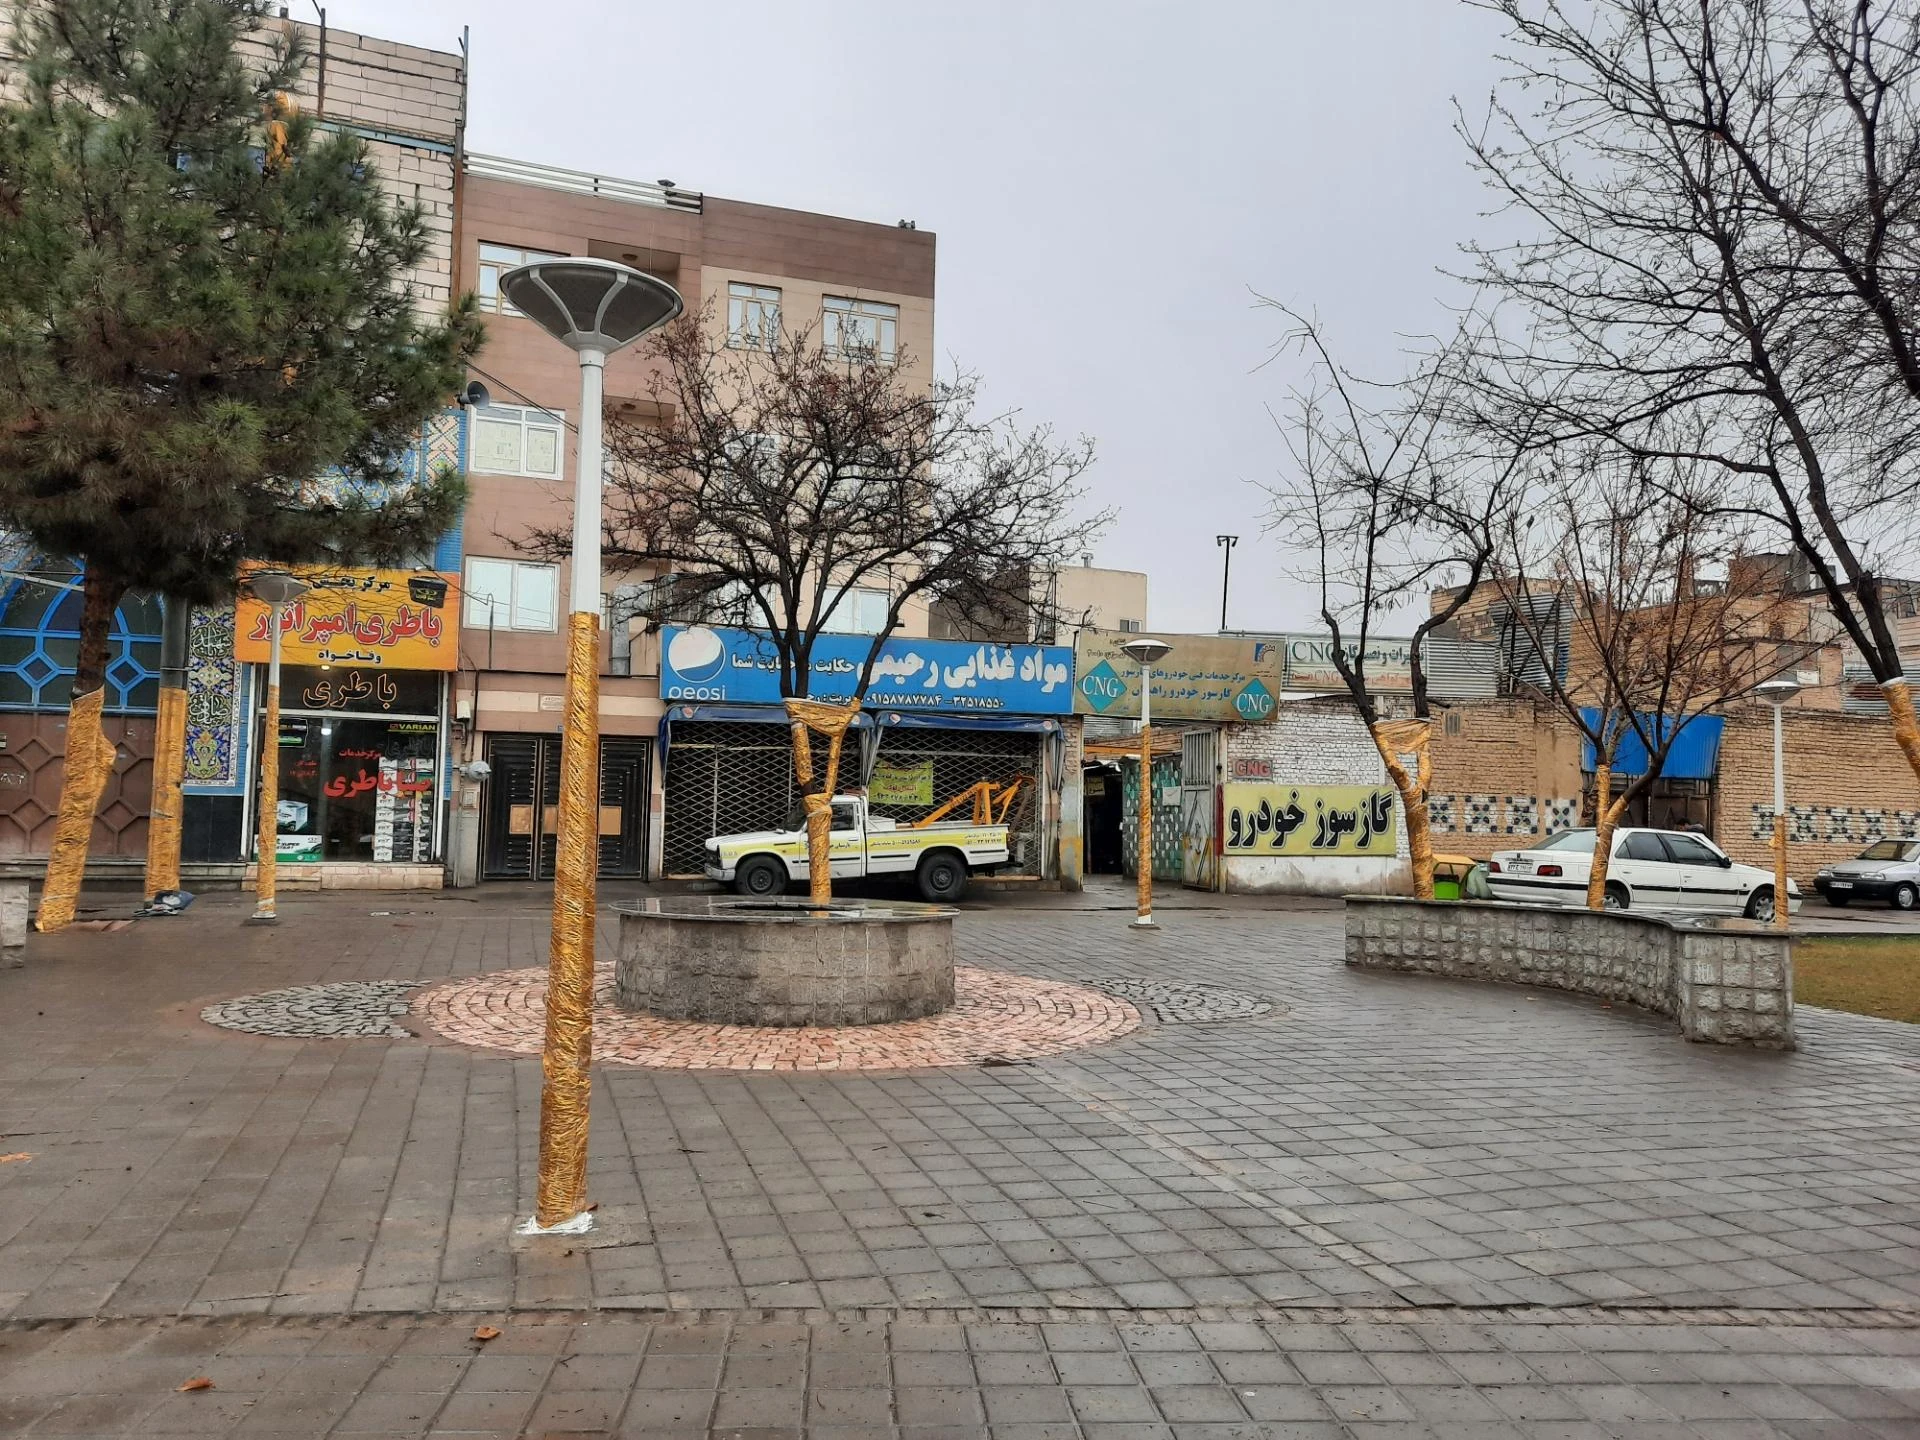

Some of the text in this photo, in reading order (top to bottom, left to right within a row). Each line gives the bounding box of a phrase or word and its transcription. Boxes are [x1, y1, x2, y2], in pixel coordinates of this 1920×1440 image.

[354, 603, 442, 647] باطری
[318, 649, 382, 664] وفاخواه
[731, 653, 754, 668] شما
[815, 656, 855, 675] حکایت
[856, 645, 1068, 693] مواد غذایی رحیمی
[302, 671, 397, 710] باطری
[668, 684, 726, 700] pepsi
[1082, 675, 1118, 697] CNG
[1236, 693, 1270, 714] CNG
[399, 723, 436, 731] VARIAN
[1235, 760, 1271, 777] CNG
[322, 768, 393, 799] باطری
[1226, 788, 1307, 849] خودرو
